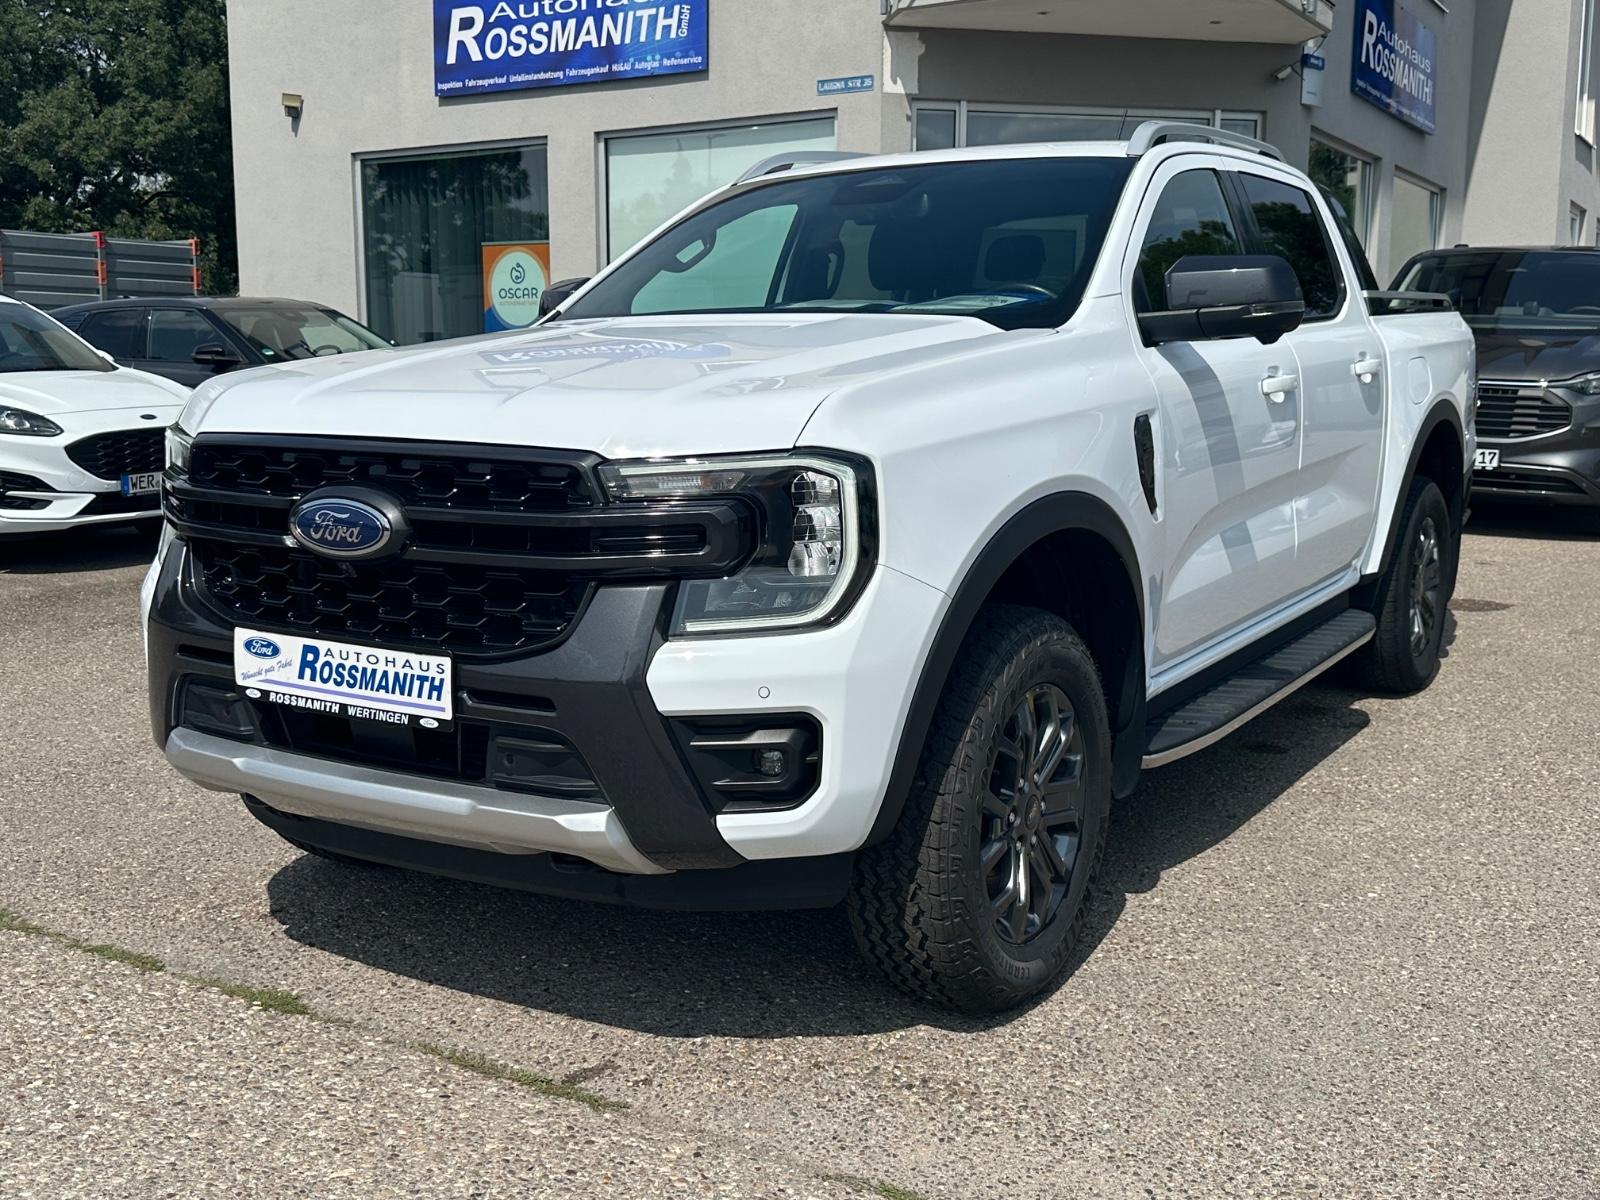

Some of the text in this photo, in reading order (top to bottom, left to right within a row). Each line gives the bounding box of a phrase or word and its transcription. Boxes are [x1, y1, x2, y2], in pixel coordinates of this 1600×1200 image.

[488, 0, 658, 23] Auto
[678, 4, 691, 38] GmbH
[446, 4, 681, 64] ROSSMANITH
[1377, 21, 1432, 73] Autohaus
[1361, 8, 1432, 105] ROSSMANITH
[437, 81, 463, 91] Inspektion
[465, 75, 507, 88] Fahrzeugverkauf
[509, 70, 564, 83] Unfallinstandsetzung
[565, 64, 609, 77] Fahrzeugankauf
[634, 61, 660, 71] Autoglas
[662, 56, 702, 67] Reifenservice
[498, 287, 539, 299] OSCAR
[1479, 451, 1497, 465] 17
[130, 474, 155, 491] WER
[310, 510, 364, 543] Ford
[250, 639, 274, 656] Ford
[323, 647, 446, 675] AUTOHAUS
[297, 643, 446, 702] ROSSMANITH
[269, 691, 340, 714] ROSSMANITH
[347, 705, 410, 725] WERTINGEN
